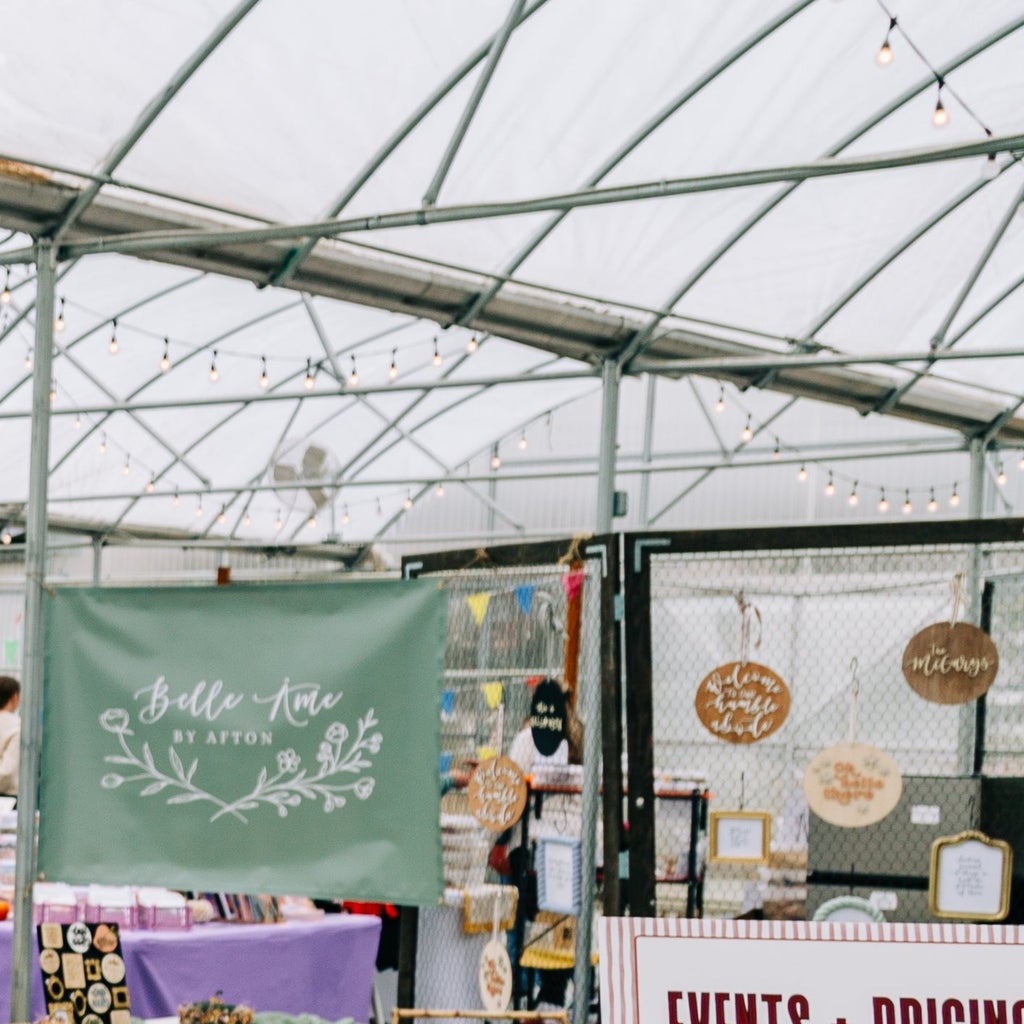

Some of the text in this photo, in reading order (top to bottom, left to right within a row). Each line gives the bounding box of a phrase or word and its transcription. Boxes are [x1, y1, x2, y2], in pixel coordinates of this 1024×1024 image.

[134, 675, 244, 725] Belle
[172, 729, 273, 746] BY AFTON
